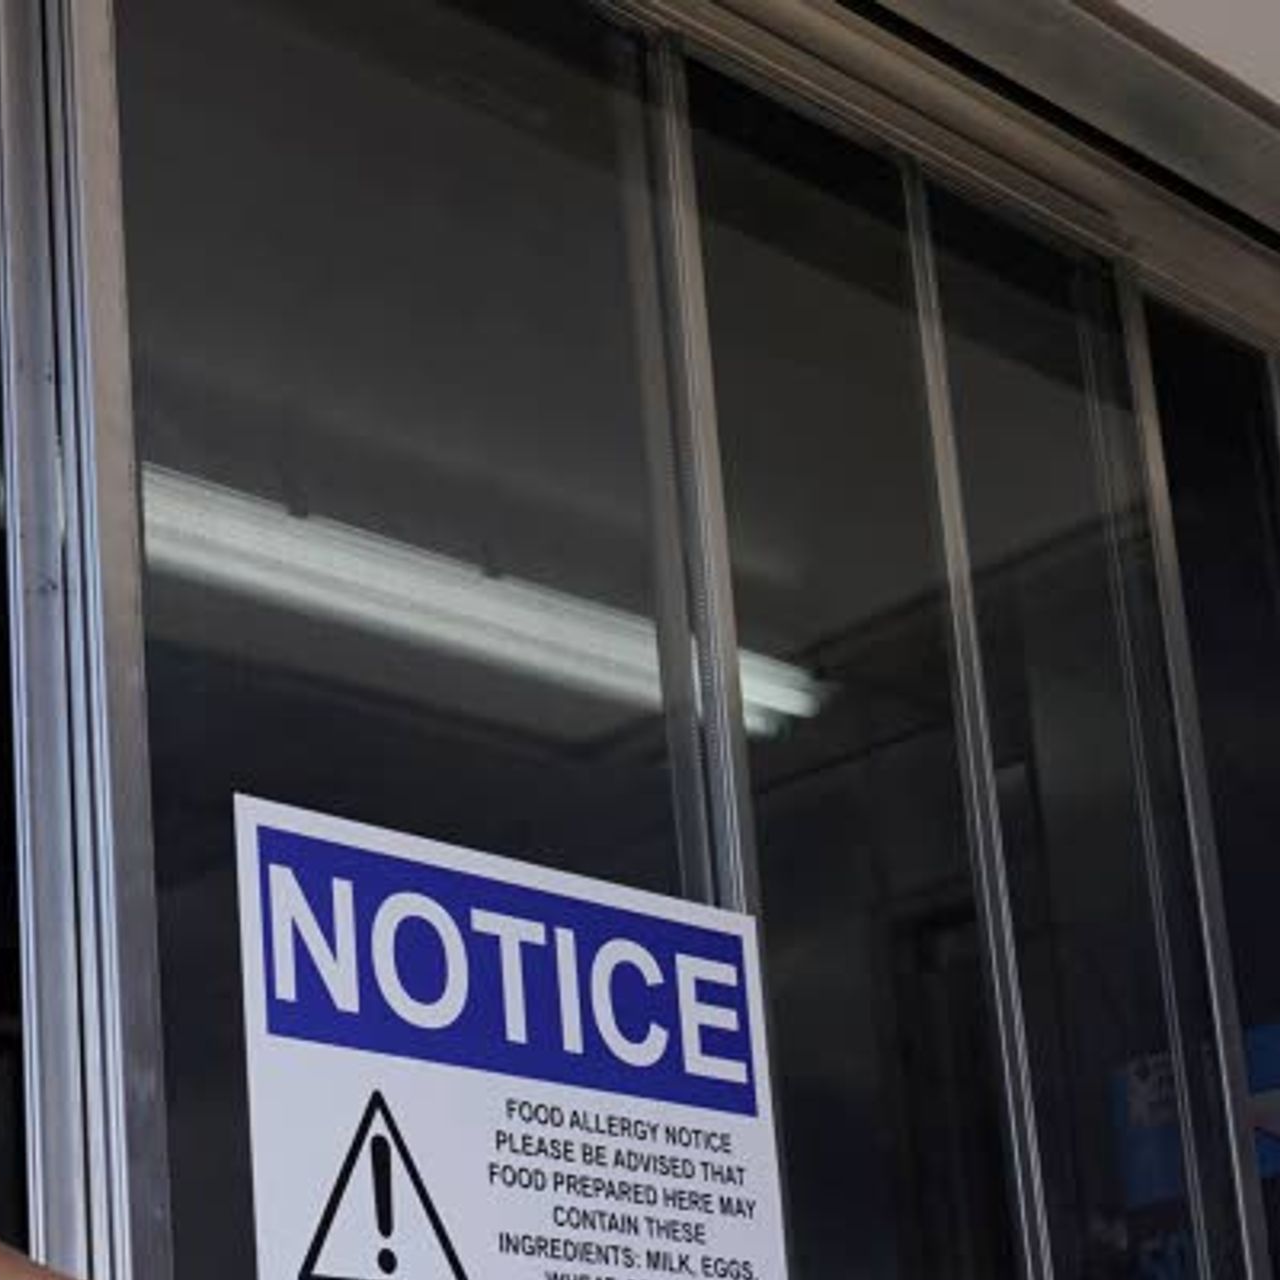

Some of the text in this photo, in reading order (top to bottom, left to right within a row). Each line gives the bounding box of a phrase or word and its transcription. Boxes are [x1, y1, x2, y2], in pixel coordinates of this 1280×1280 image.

[267, 862, 749, 1085] NOTICE
[505, 1098, 733, 1154] FOOD ALLERGY NOTICE
[495, 1129, 746, 1186] PLEASE BE ADVISED THAT
[488, 1162, 757, 1220] FOOD PREPARED HERE MAY
[552, 1205, 707, 1246] CONTAIN THESE
[497, 1232, 642, 1269] INGREDIENTS:
[645, 1250, 698, 1277] MILK,
